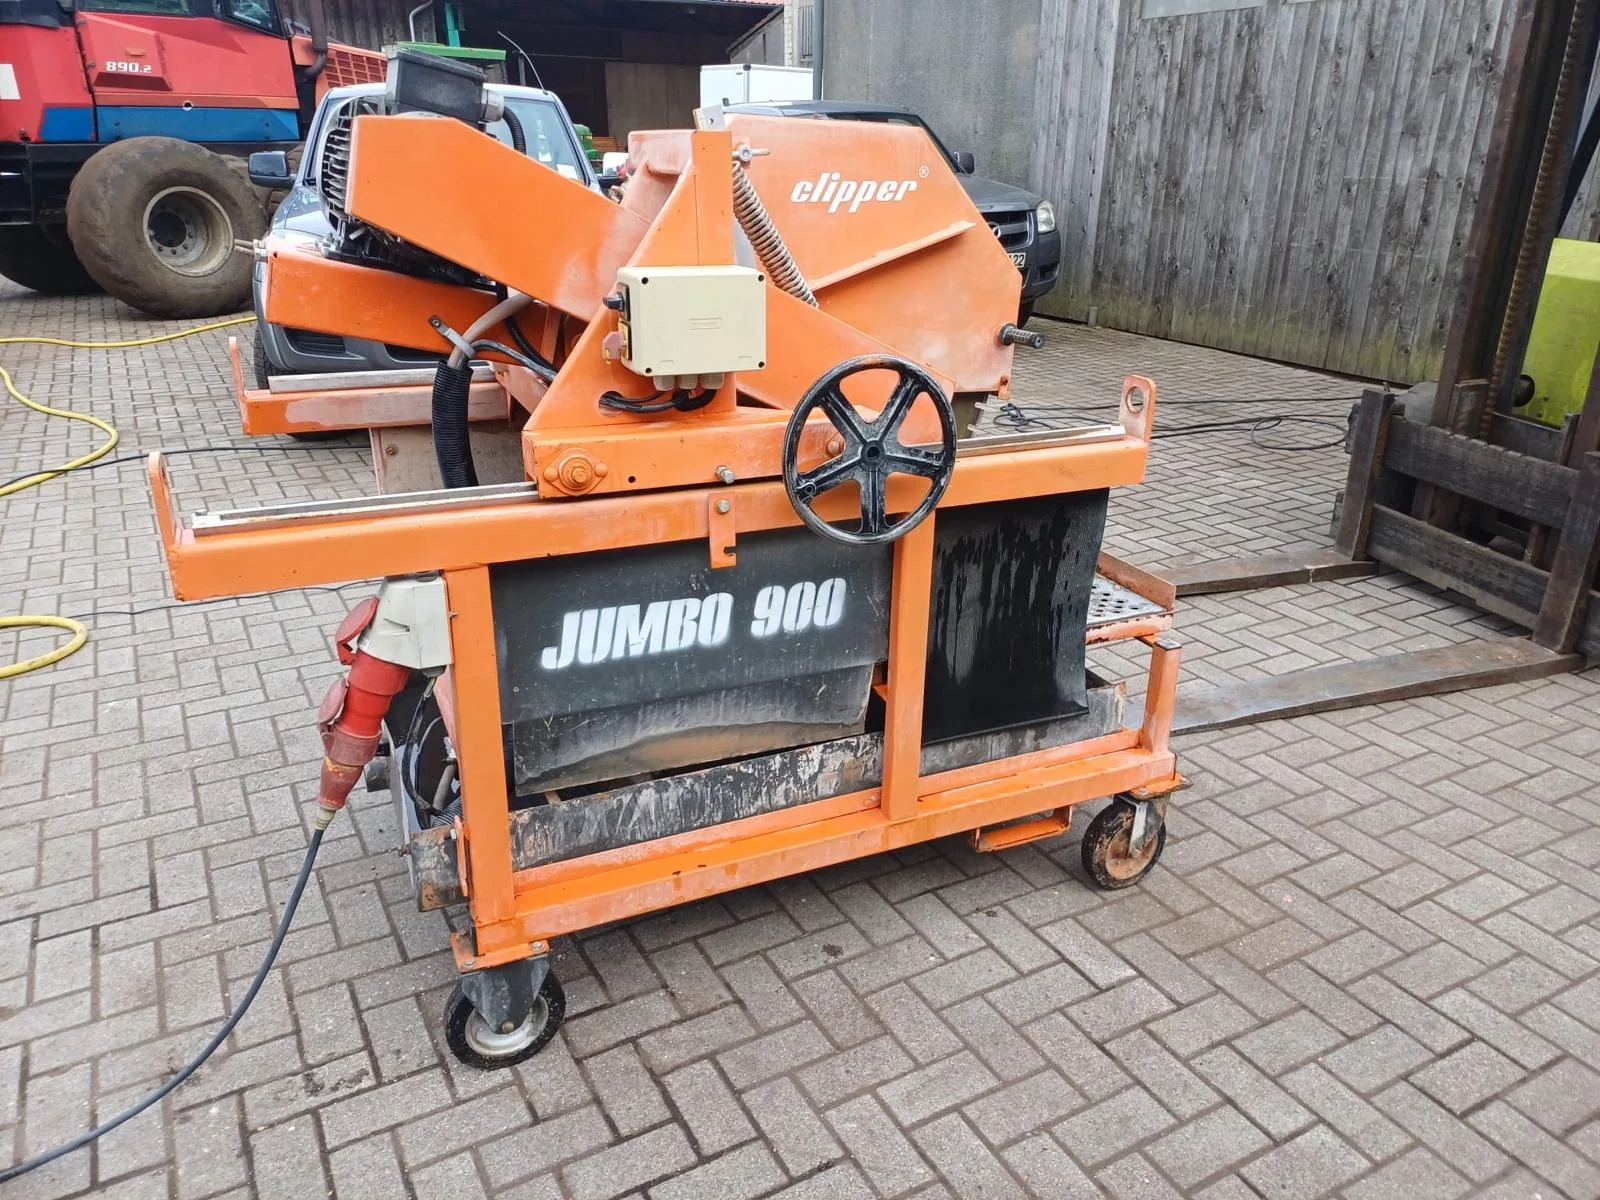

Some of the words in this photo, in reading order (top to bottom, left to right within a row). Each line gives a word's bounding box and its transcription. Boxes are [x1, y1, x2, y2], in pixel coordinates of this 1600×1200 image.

[105, 61, 152, 74] 890.2
[1009, 254, 1025, 267] 22
[541, 592, 735, 670] JUMBO
[751, 577, 847, 637] 900
